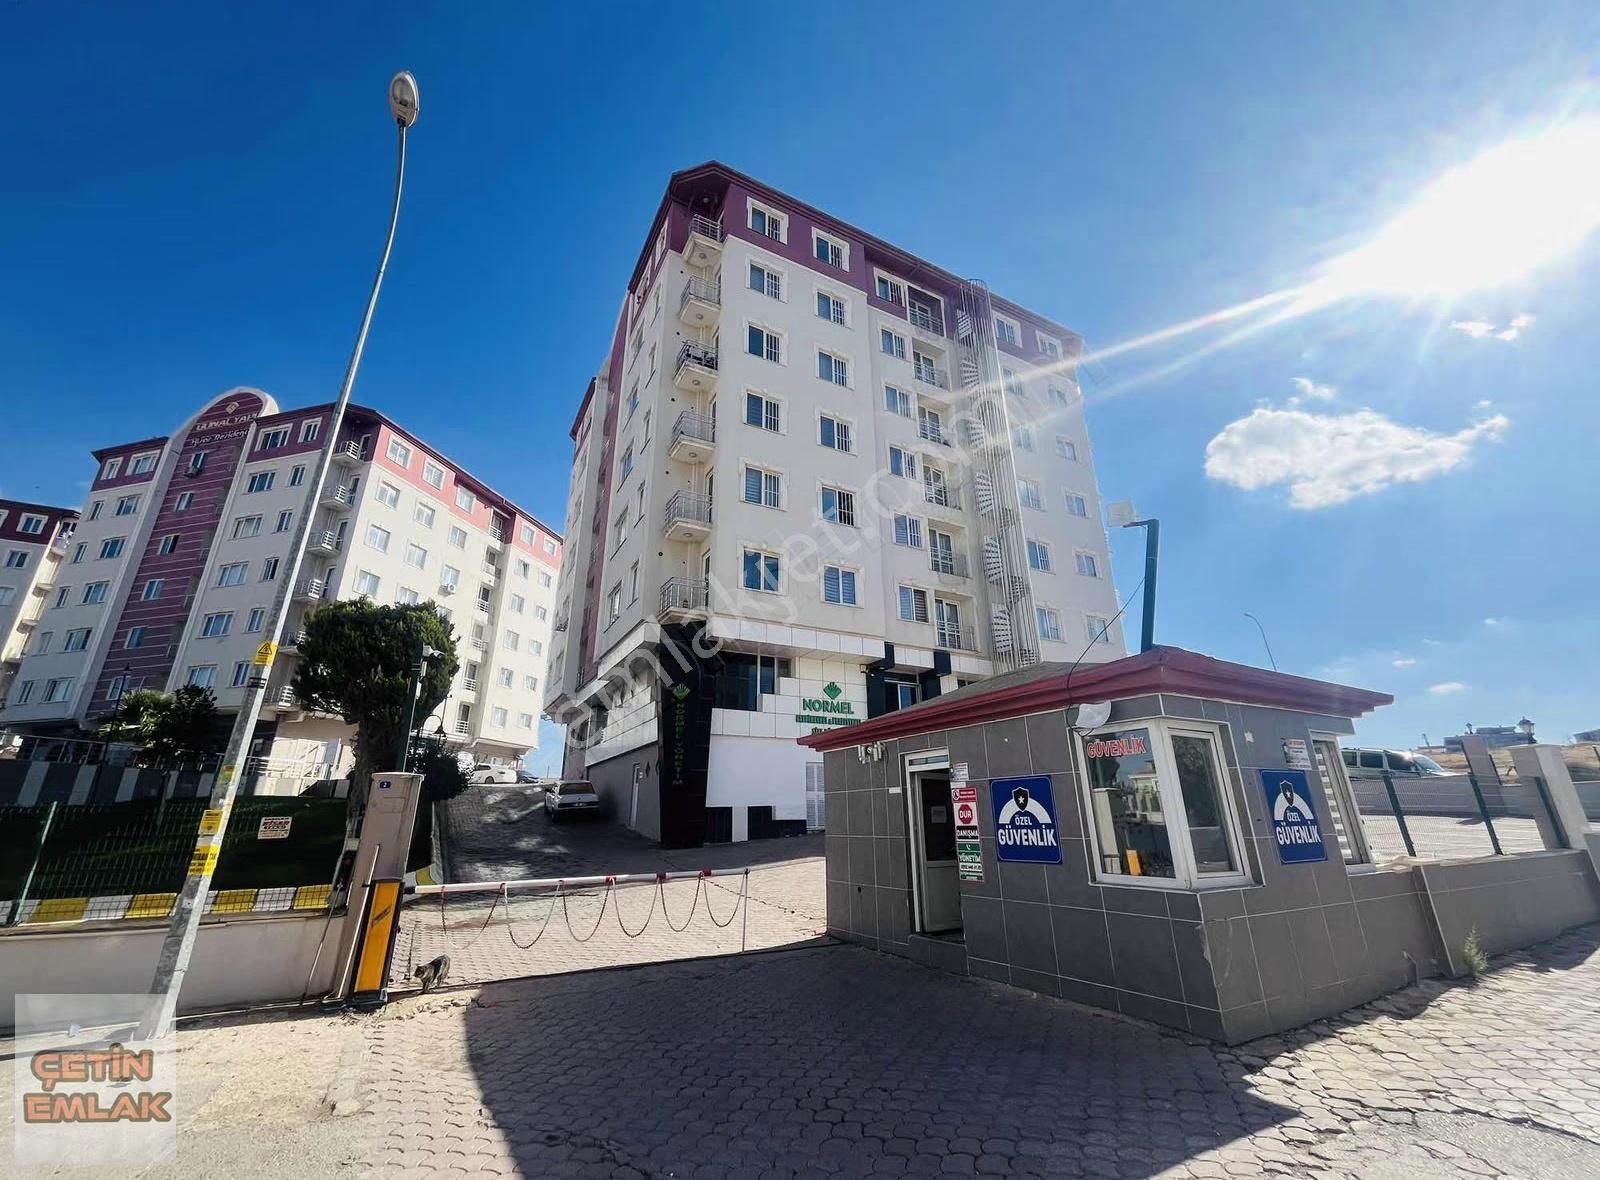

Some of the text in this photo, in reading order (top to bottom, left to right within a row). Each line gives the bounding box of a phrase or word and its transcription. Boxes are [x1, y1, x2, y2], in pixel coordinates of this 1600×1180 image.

[802, 698, 855, 715] NORMEL
[1087, 734, 1147, 759] GÜVENLİK
[959, 810, 972, 819] DUR
[1015, 815, 1032, 826] ÖZEL
[1286, 810, 1301, 822] ÖZEL
[956, 829, 979, 839] DANIŞMA
[997, 824, 1057, 847] GÜVENLİK
[1275, 820, 1322, 846] GÜVENLİK
